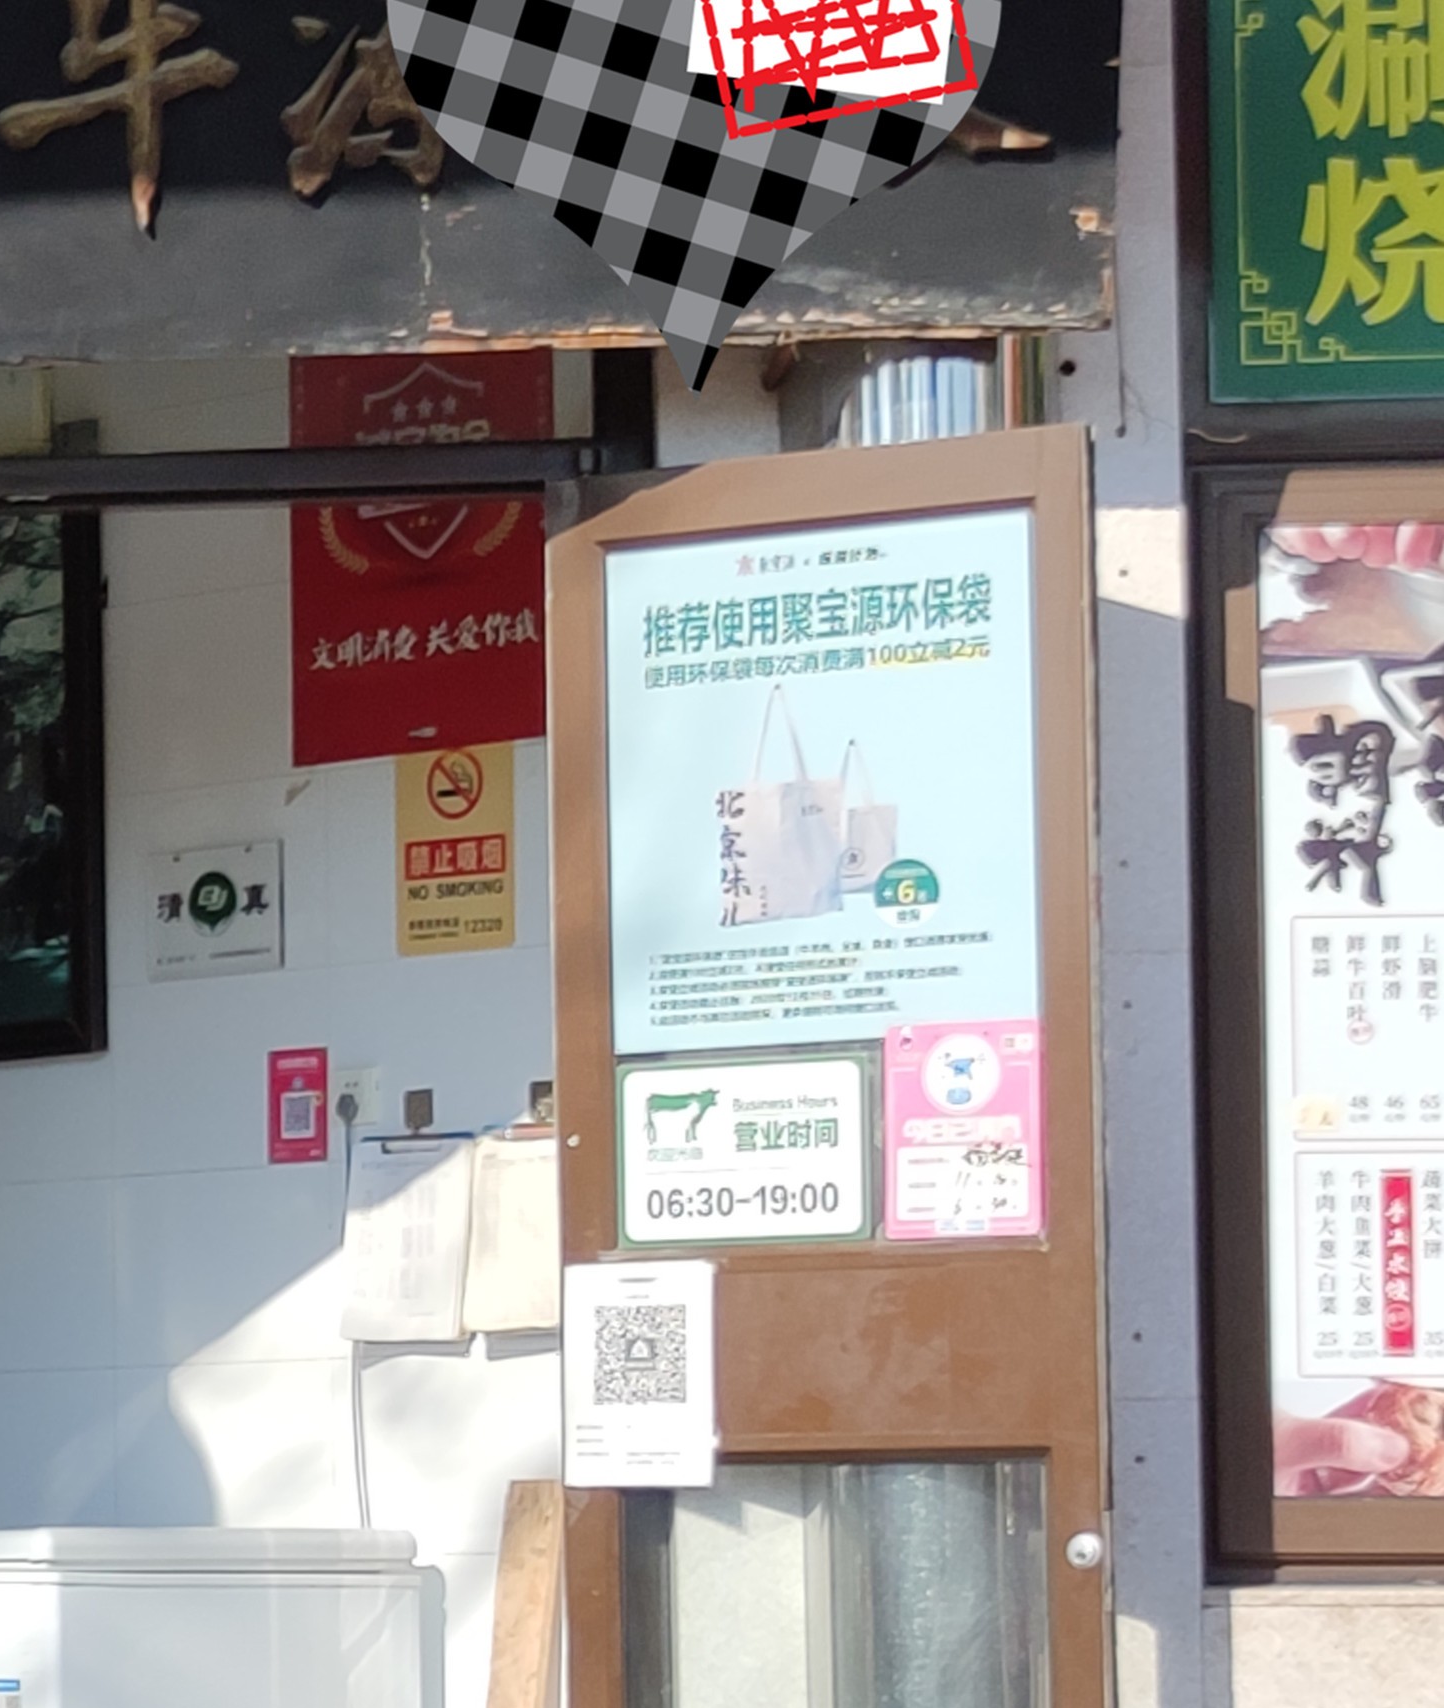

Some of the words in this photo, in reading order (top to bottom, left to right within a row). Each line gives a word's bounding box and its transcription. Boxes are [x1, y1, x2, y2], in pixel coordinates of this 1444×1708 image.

[641, 571, 993, 659] 推荐使用聚宝源环保袋
[409, 838, 503, 877] 禁止吸烟
[407, 884, 430, 901] NO
[435, 878, 505, 900] SMOKING
[732, 1097, 794, 1113] Business
[796, 1094, 839, 1110] Hours
[732, 1116, 839, 1153] 营业时间
[646, 1181, 840, 1220] 06:30-19:00
